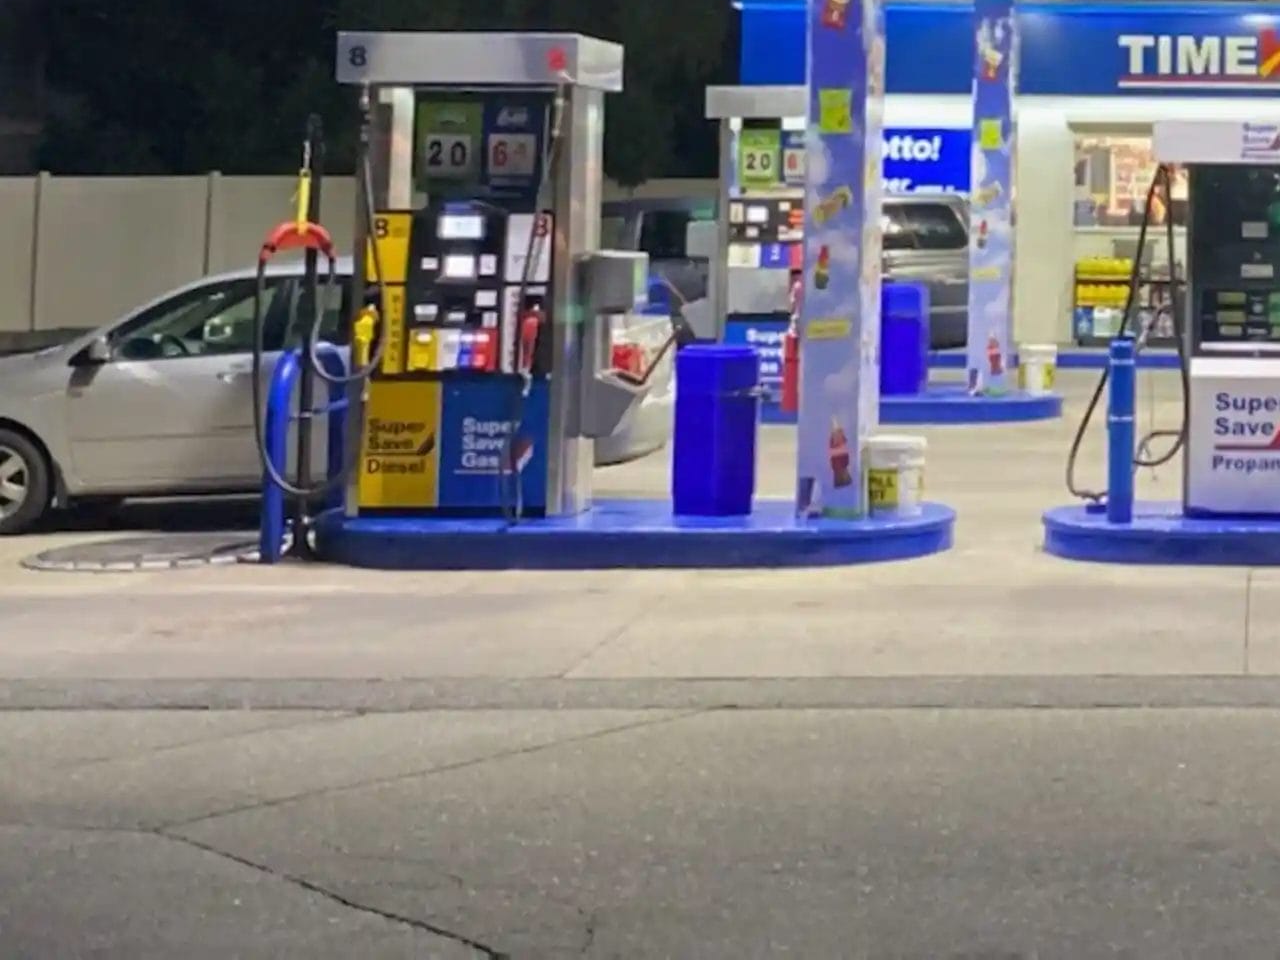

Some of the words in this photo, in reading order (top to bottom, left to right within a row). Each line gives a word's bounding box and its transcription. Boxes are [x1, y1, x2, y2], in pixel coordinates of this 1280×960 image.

[350, 45, 367, 67] 8
[1118, 34, 1258, 76] TIME
[1214, 417, 1274, 436] Save
